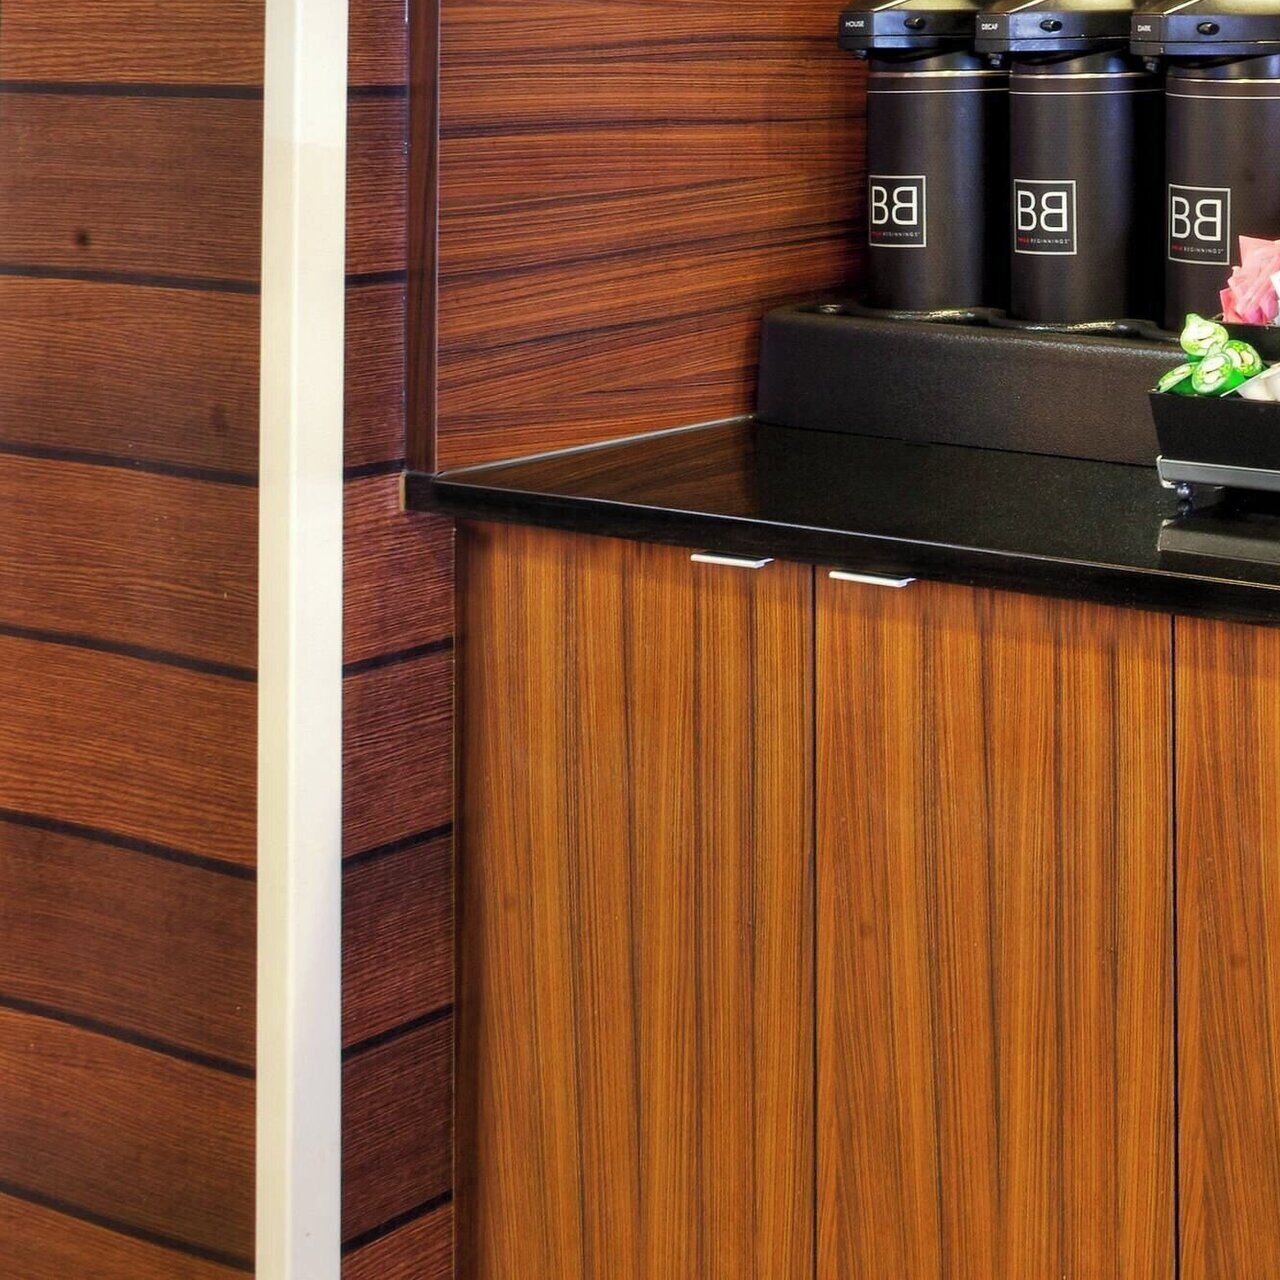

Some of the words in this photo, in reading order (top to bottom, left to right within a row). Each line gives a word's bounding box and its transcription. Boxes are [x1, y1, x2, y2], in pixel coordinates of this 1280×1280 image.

[845, 20, 865, 28] HOUSE
[981, 22, 998, 31] DECAF
[1137, 24, 1152, 32] DARK
[872, 186, 918, 225] BB
[1017, 190, 1068, 232] BB
[1172, 196, 1222, 241] BB
